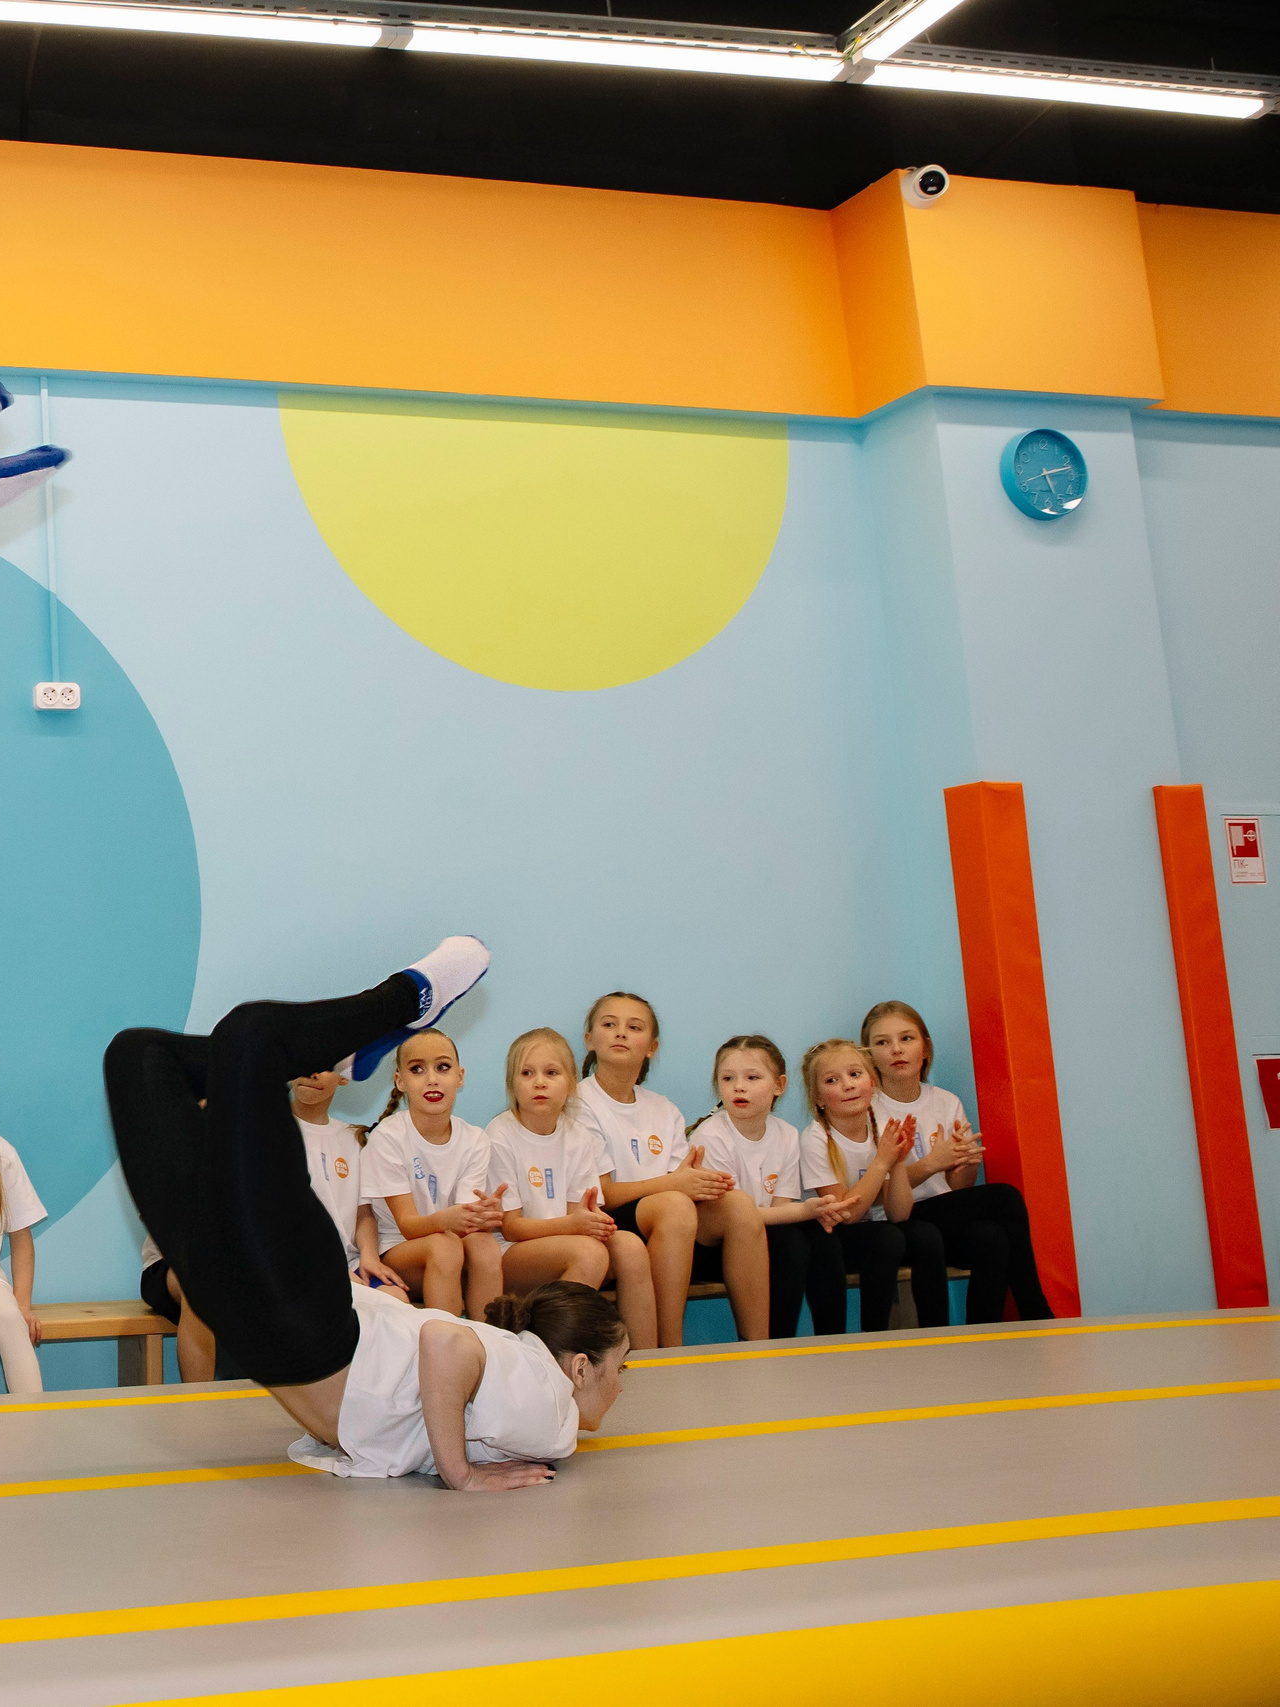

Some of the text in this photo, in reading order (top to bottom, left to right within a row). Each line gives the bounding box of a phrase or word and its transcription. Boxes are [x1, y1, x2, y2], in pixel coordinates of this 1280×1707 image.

[1062, 454, 1071, 467] 2
[1065, 484, 1073, 495] 4
[1030, 491, 1039, 505] 7
[1043, 497, 1053, 509] 6
